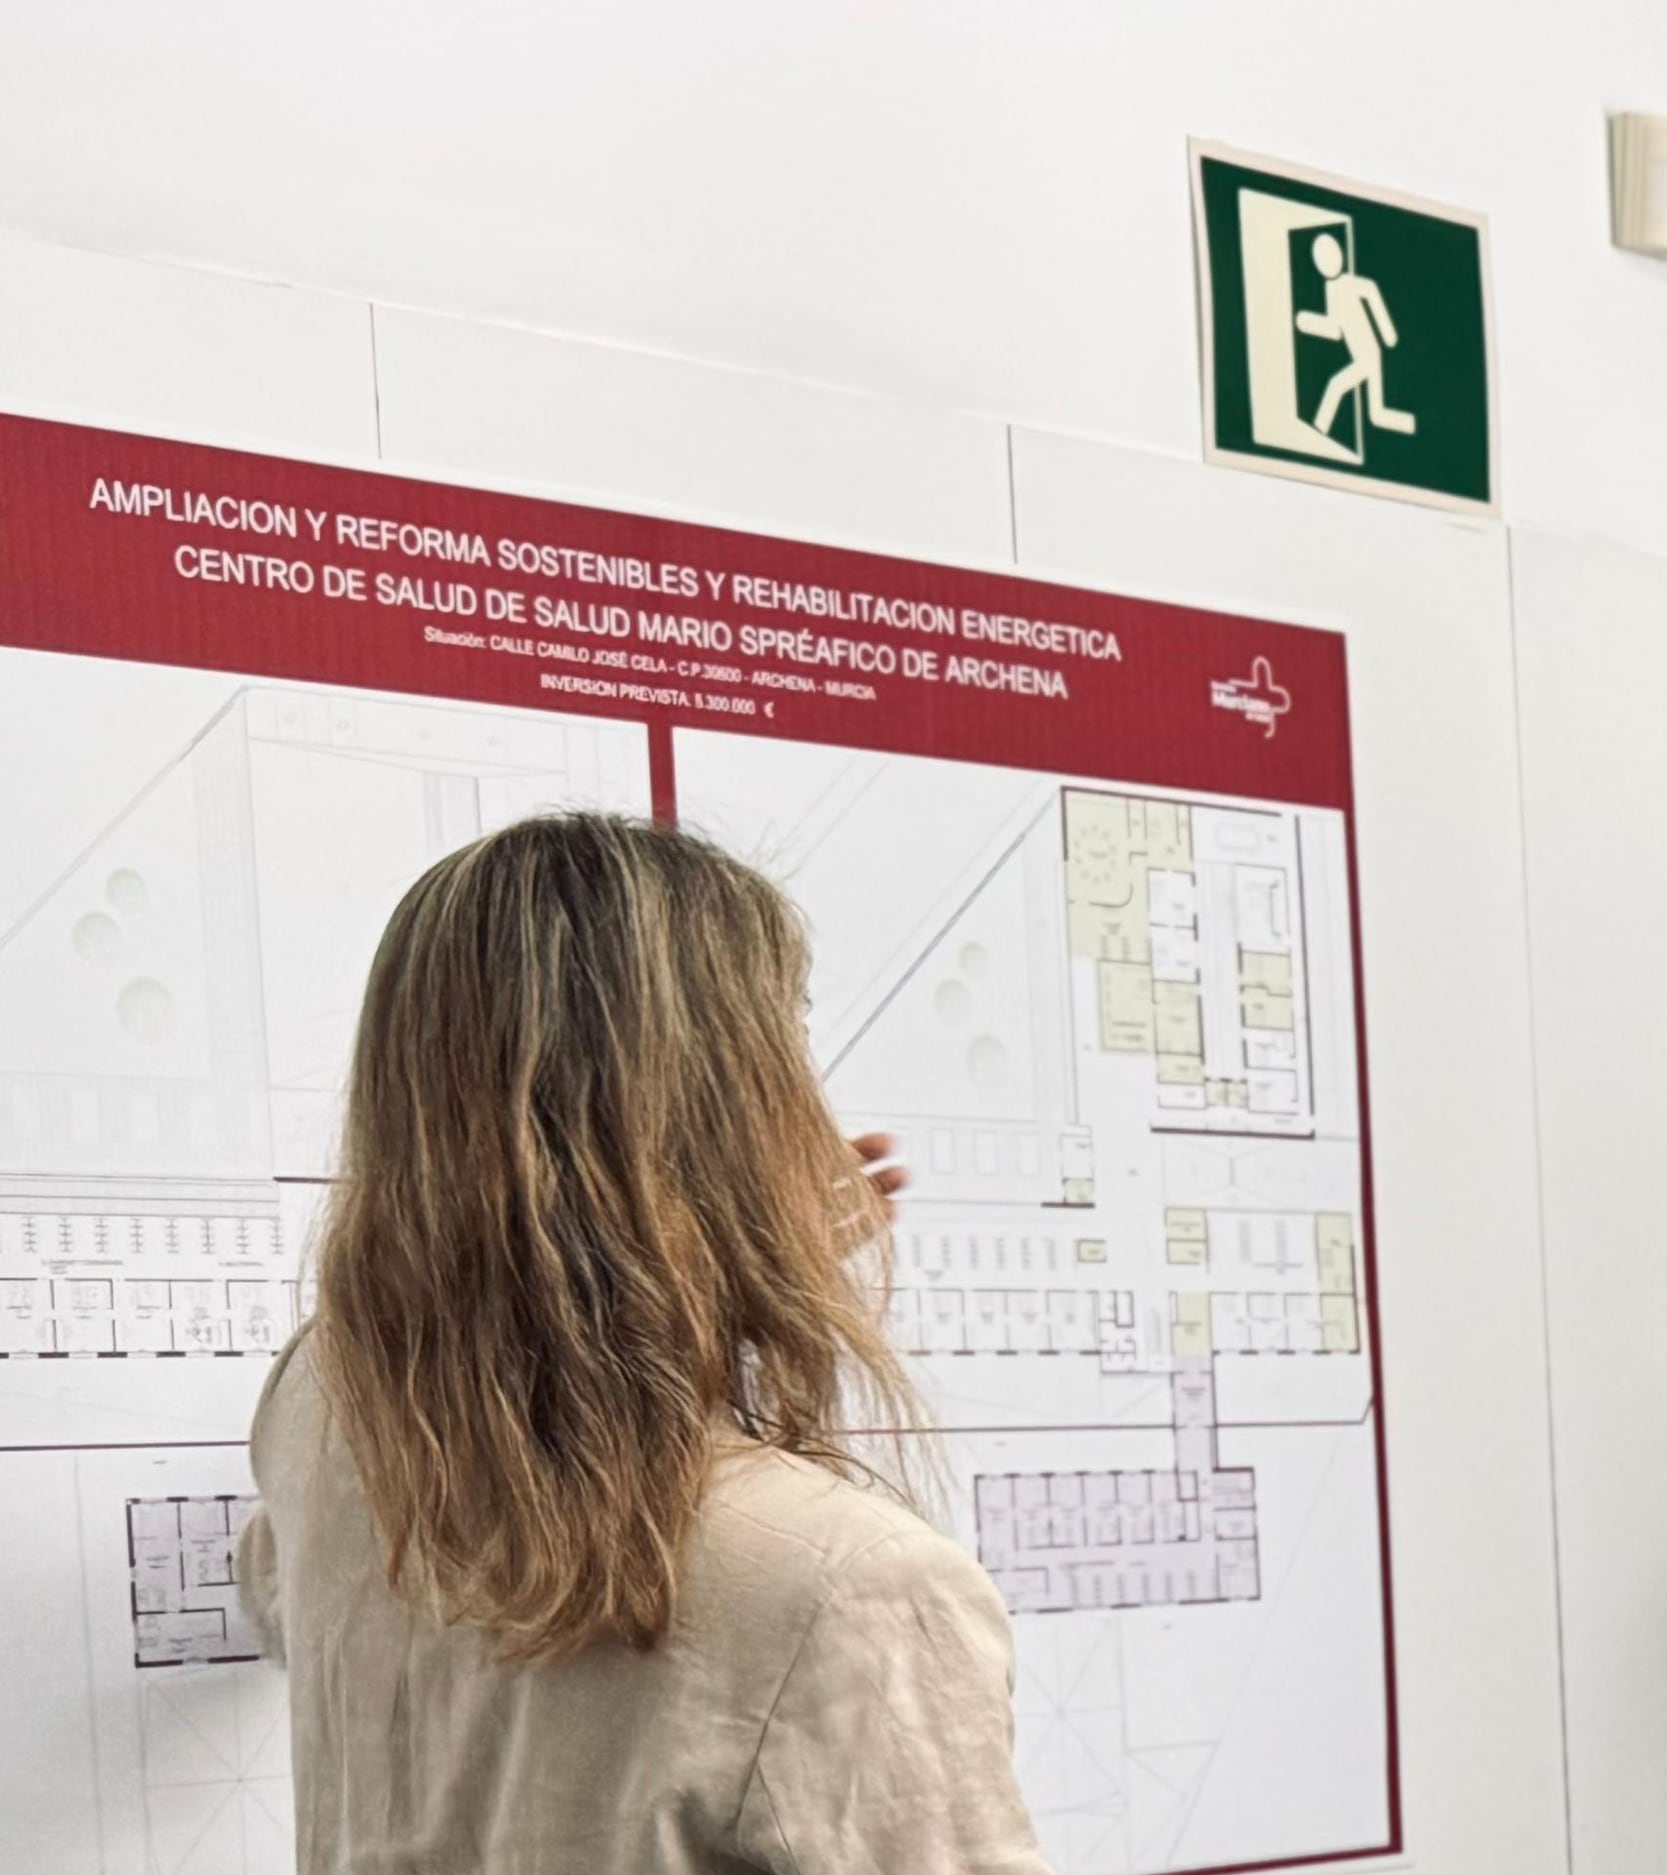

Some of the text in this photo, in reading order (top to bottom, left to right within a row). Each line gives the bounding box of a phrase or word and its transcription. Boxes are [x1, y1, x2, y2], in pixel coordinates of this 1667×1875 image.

[90, 478, 1121, 662] AMPLIACION Y REFORMA SOSTENIBLES Y REHABILITACION ENERGETICA
[174, 545, 1068, 699] CENTRO DE SALUD DE SALUD MARIO SPRÉAFICO DE ARCHENA
[490, 634, 534, 657] CALLE
[537, 641, 590, 665] CAMILO
[591, 648, 628, 670] JOSÉ
[630, 653, 668, 674] CELA
[751, 671, 815, 693] ARCHENA
[824, 680, 877, 701] MURCIA
[540, 673, 617, 700] INVERSION
